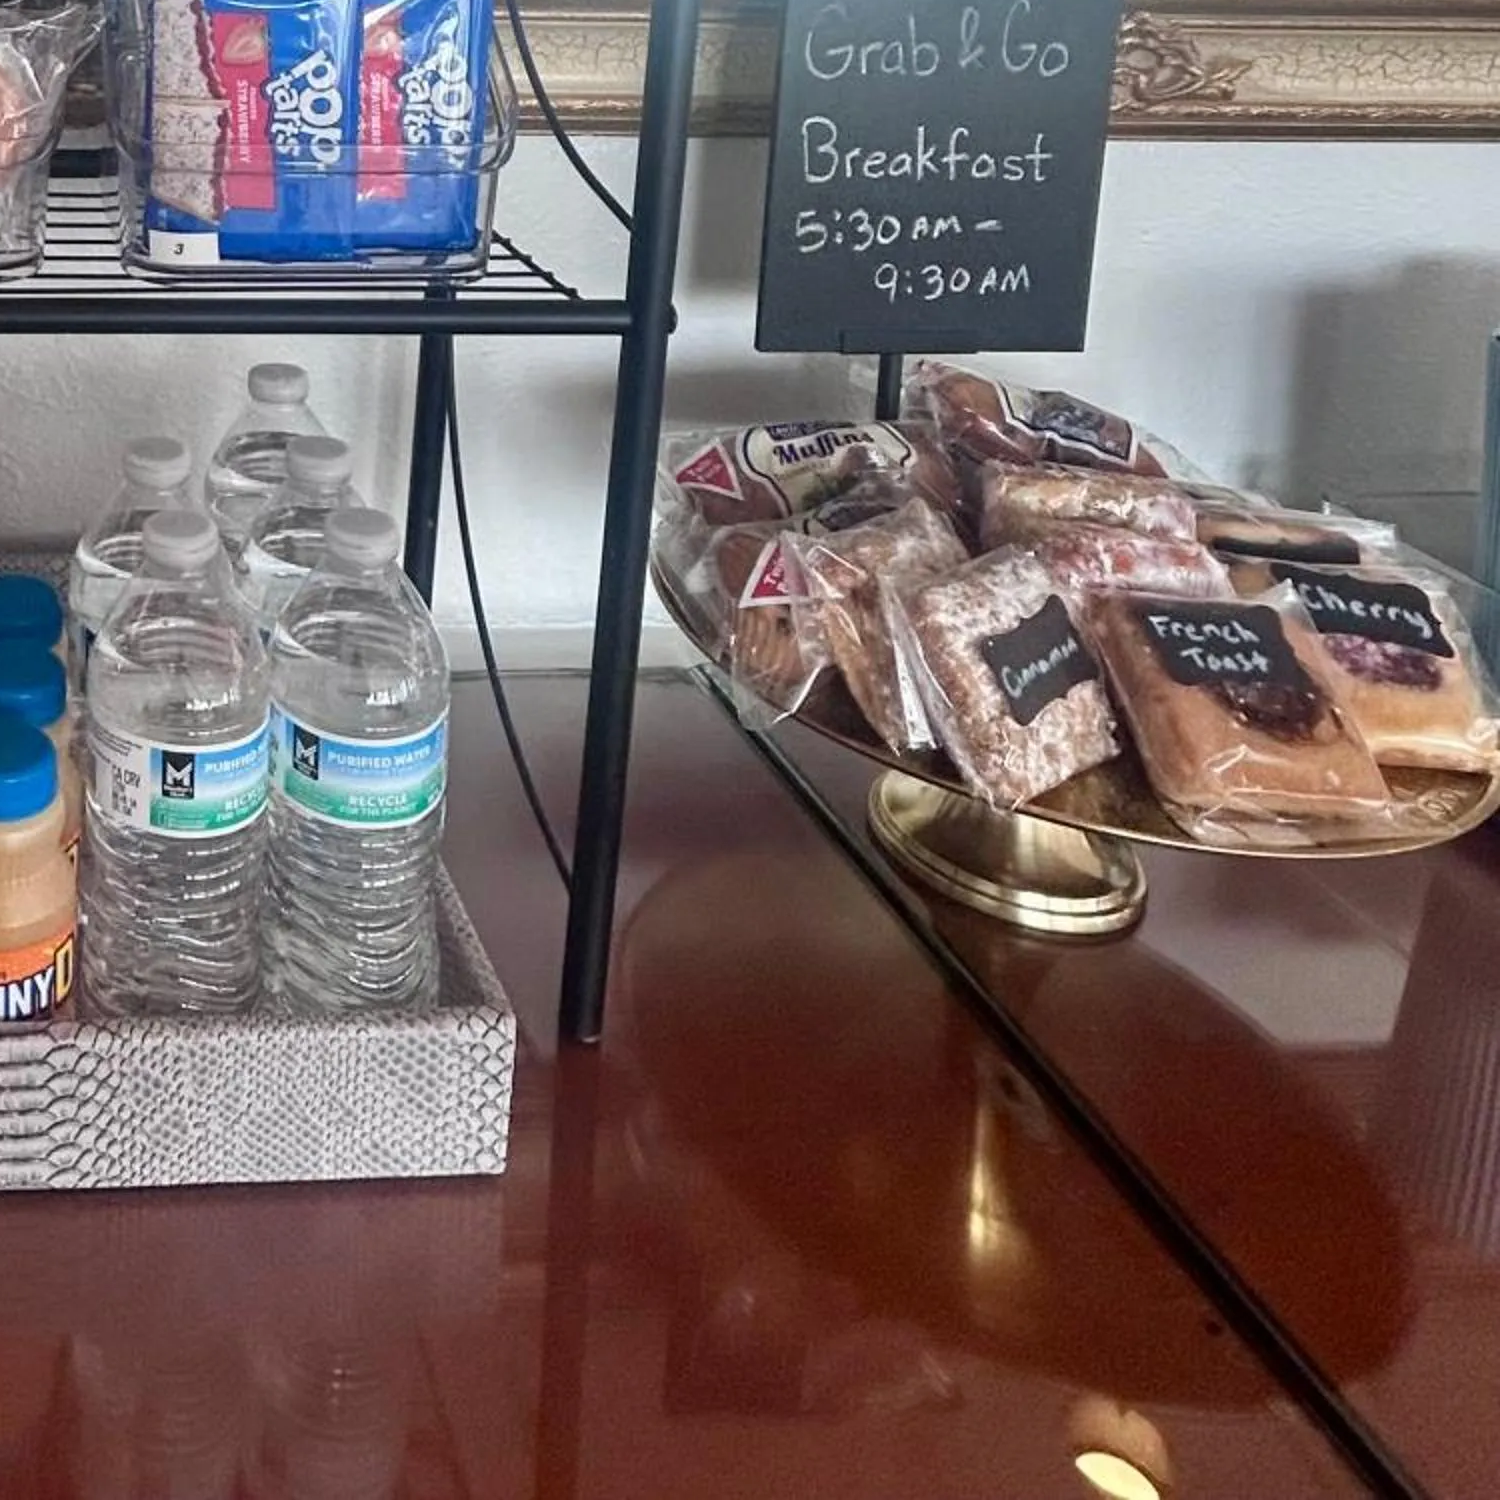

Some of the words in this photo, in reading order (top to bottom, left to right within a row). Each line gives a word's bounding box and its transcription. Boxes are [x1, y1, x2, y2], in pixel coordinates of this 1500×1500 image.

[804, 3, 941, 80] Grab
[959, 7, 990, 71] &
[801, 115, 1054, 183] Breakfast
[173, 243, 184, 254] 3
[794, 208, 901, 253] 5:30
[874, 263, 971, 302] 9:30
[773, 431, 875, 465] Muffins
[1148, 614, 1260, 643] French
[1298, 582, 1433, 640] Cherry
[1181, 647, 1269, 673] Toast
